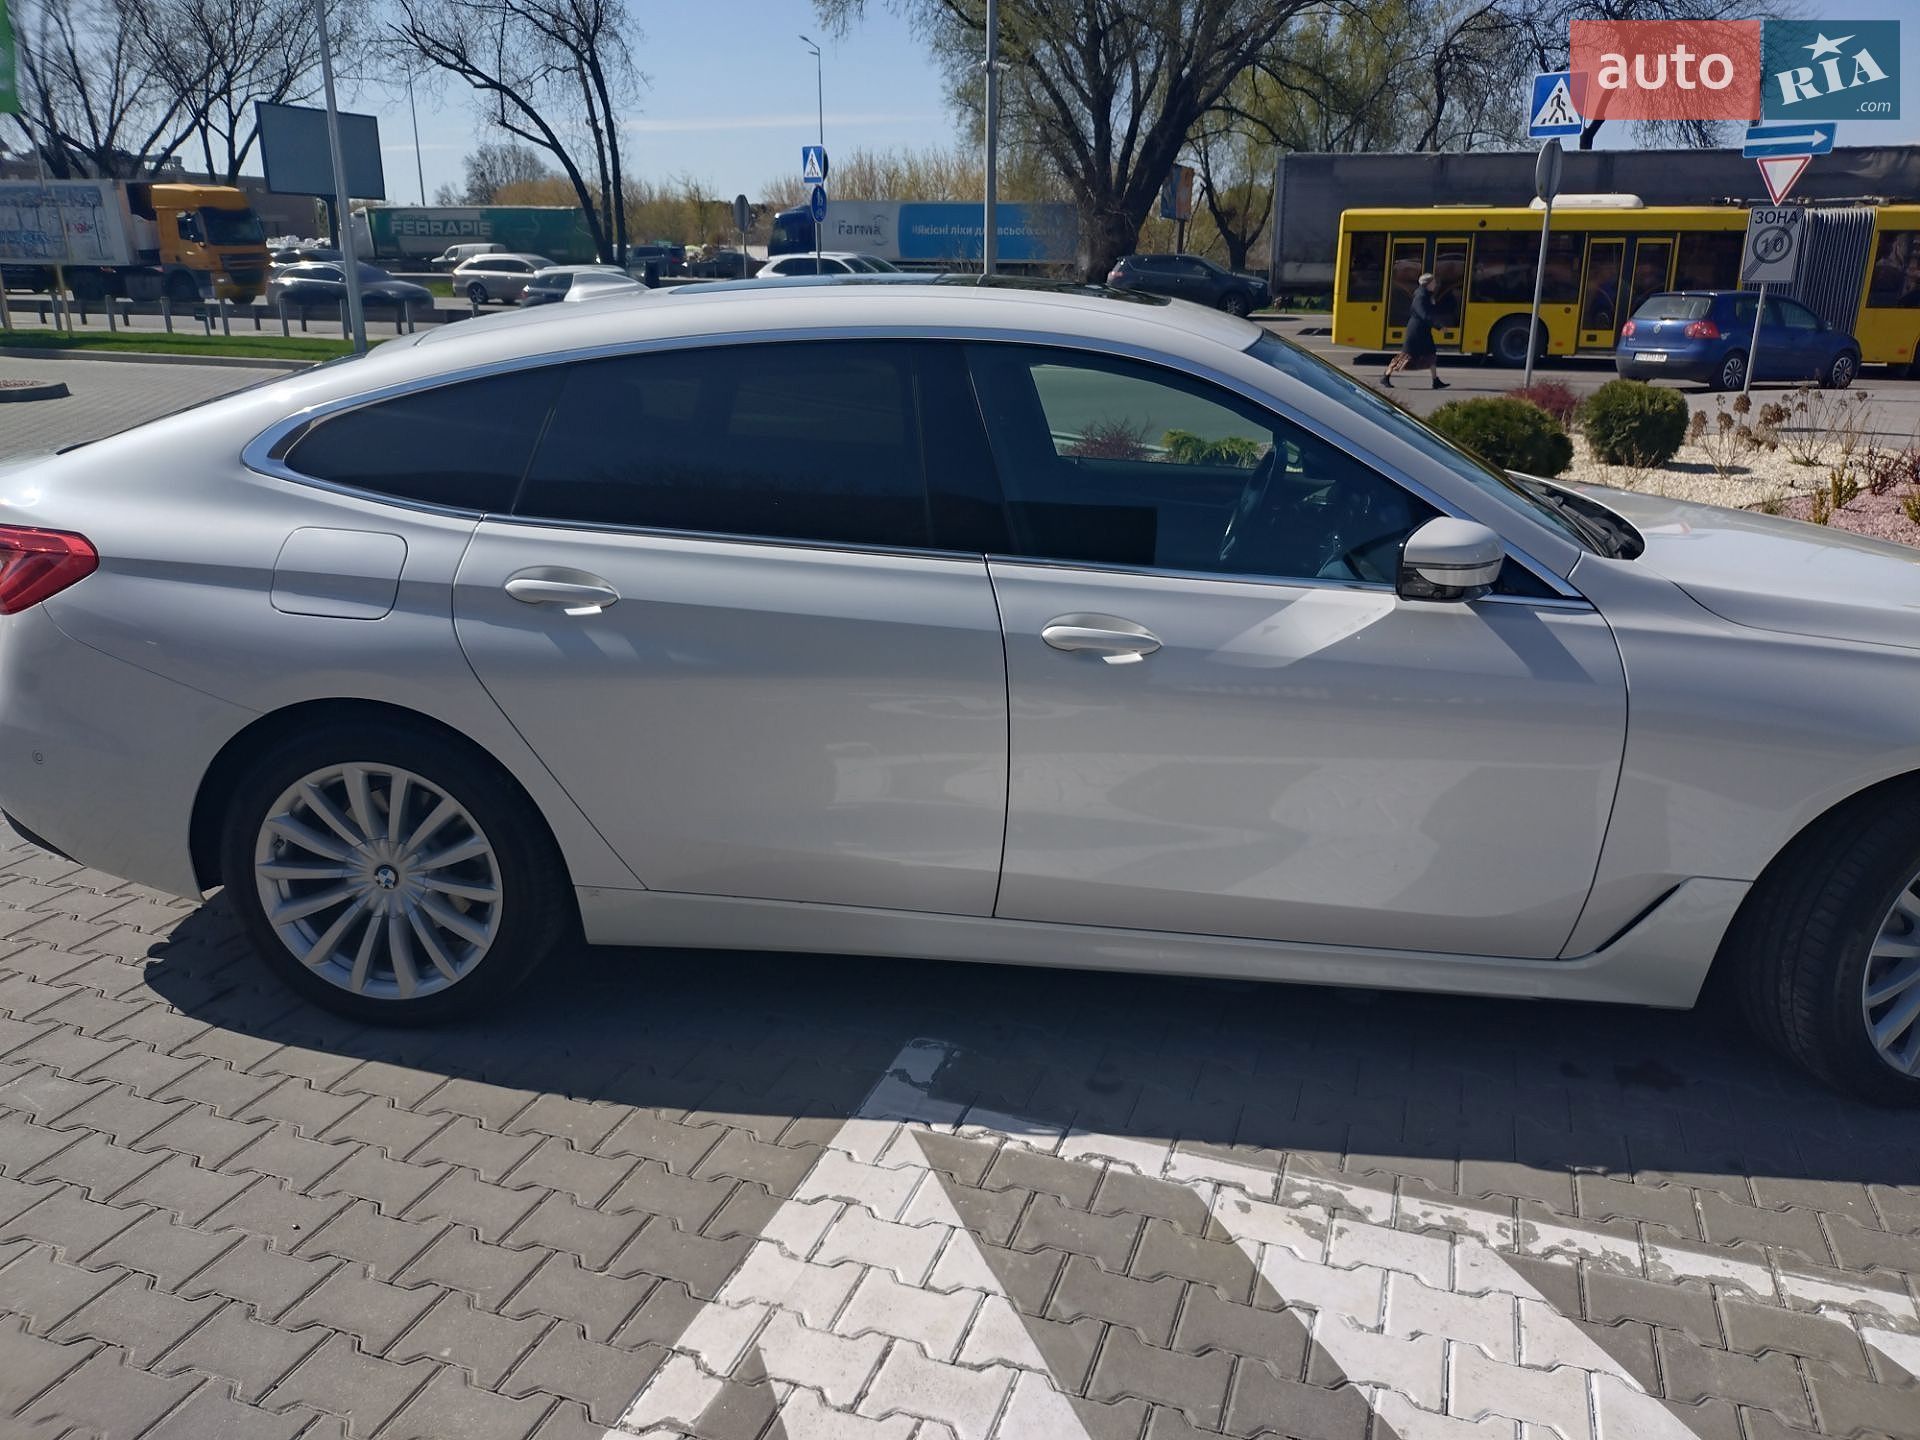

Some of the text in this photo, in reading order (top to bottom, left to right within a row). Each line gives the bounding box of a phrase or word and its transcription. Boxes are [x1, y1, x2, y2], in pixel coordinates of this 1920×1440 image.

[1754, 210, 1799, 225] ЗОНА
[390, 220, 493, 236] FERRAPIE
[1761, 237, 1785, 254] 10
